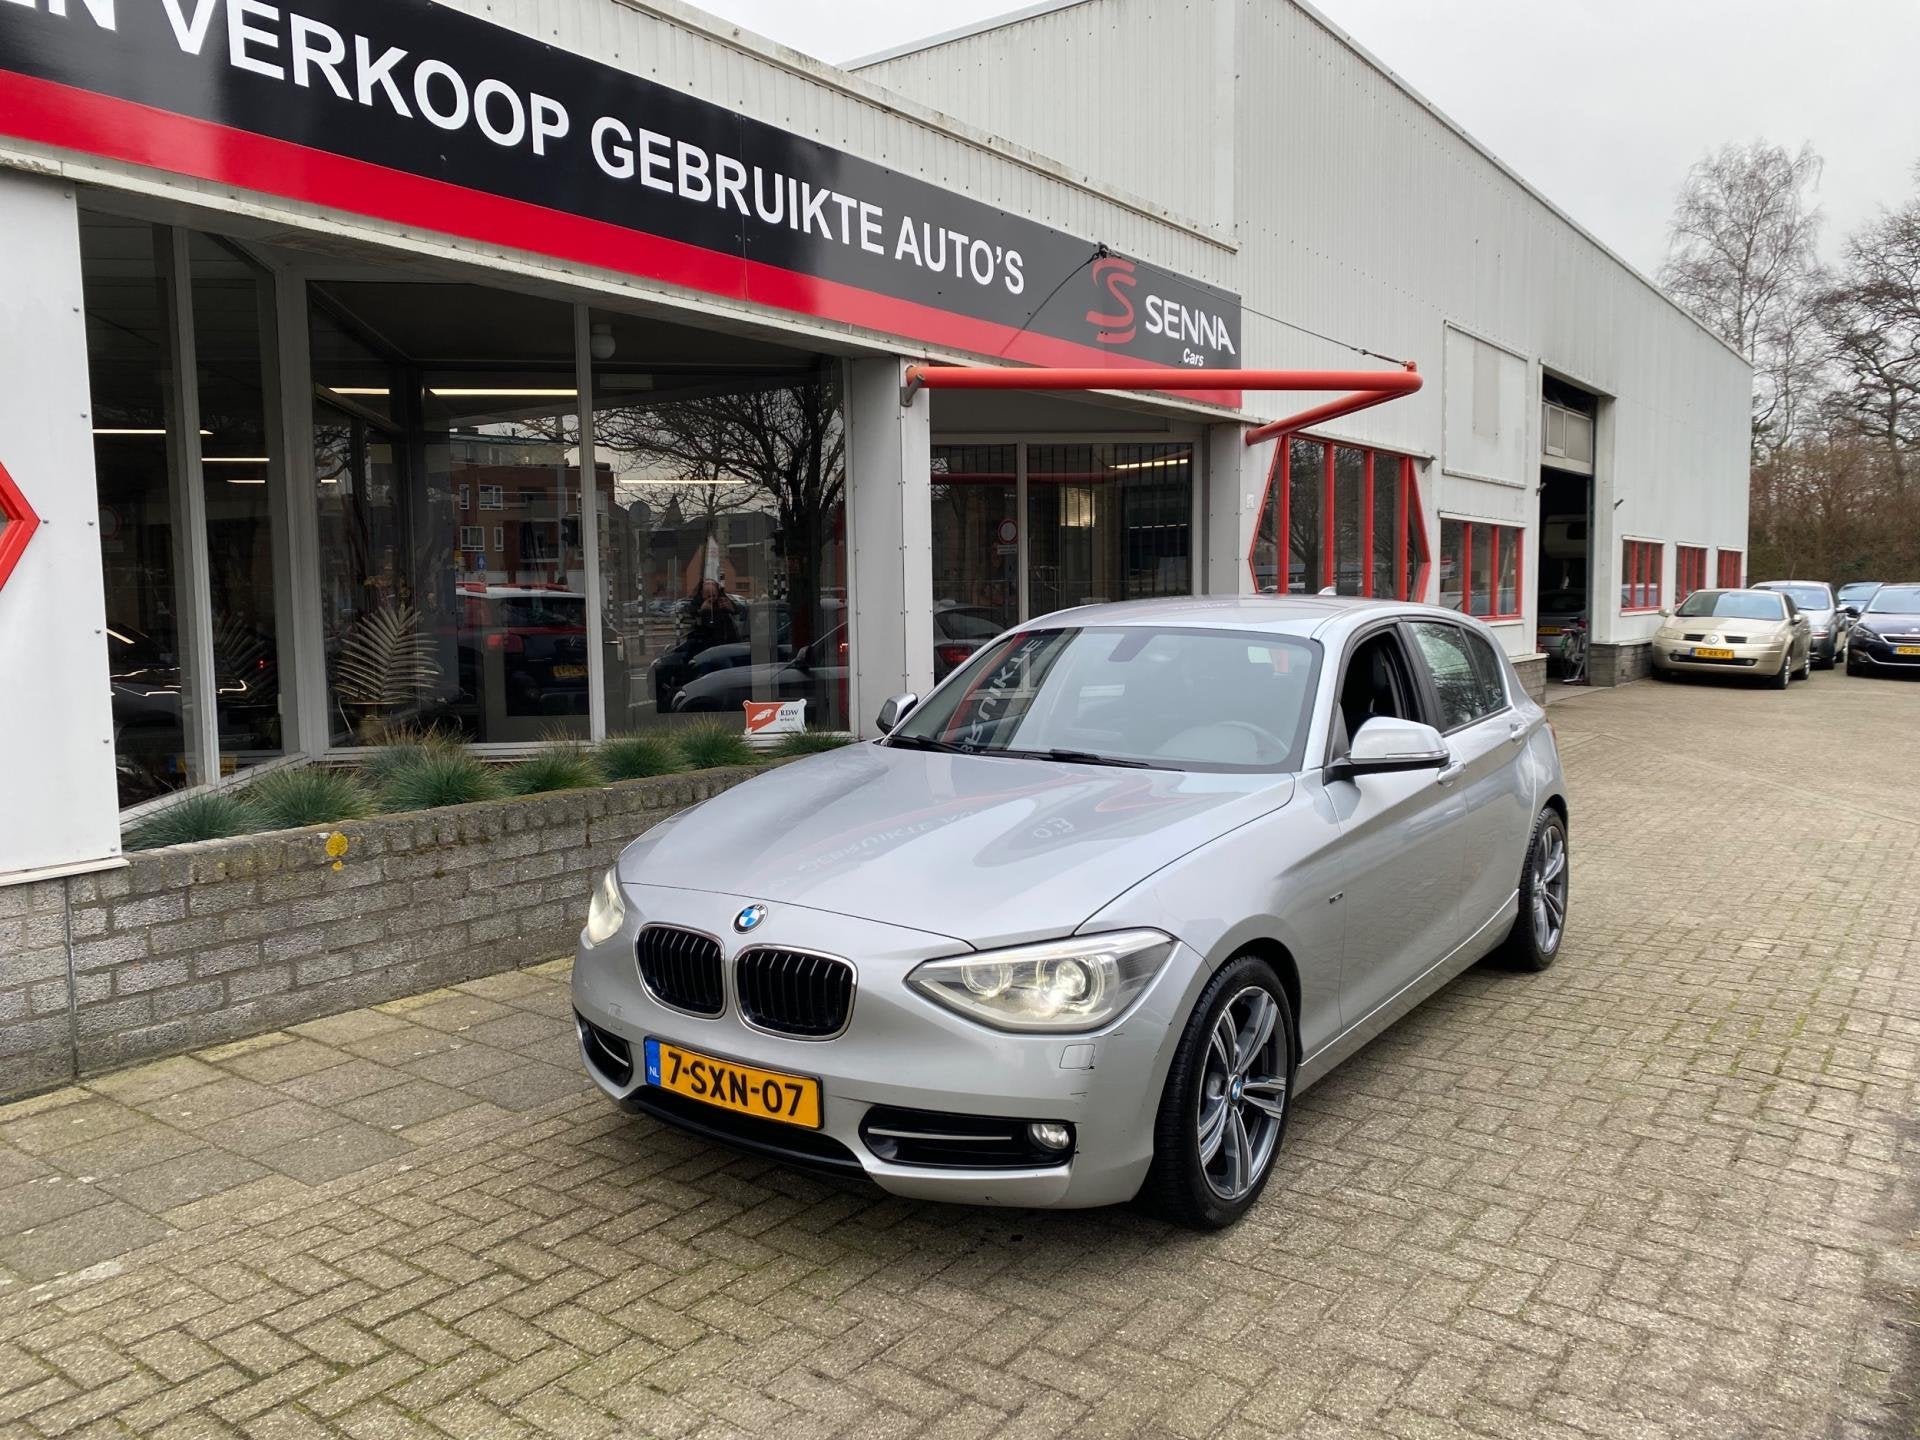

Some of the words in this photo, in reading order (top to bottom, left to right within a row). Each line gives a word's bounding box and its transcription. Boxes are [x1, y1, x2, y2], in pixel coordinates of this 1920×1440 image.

[161, 0, 570, 156] VERKOOP
[591, 116, 885, 255] GEBRUIKTE
[895, 216, 1025, 295] AUTO'S
[1145, 294, 1236, 355] SENNA
[1183, 348, 1204, 367] Cars
[650, 1066, 660, 1078] NL
[668, 1051, 803, 1117] 7-SXN-07
